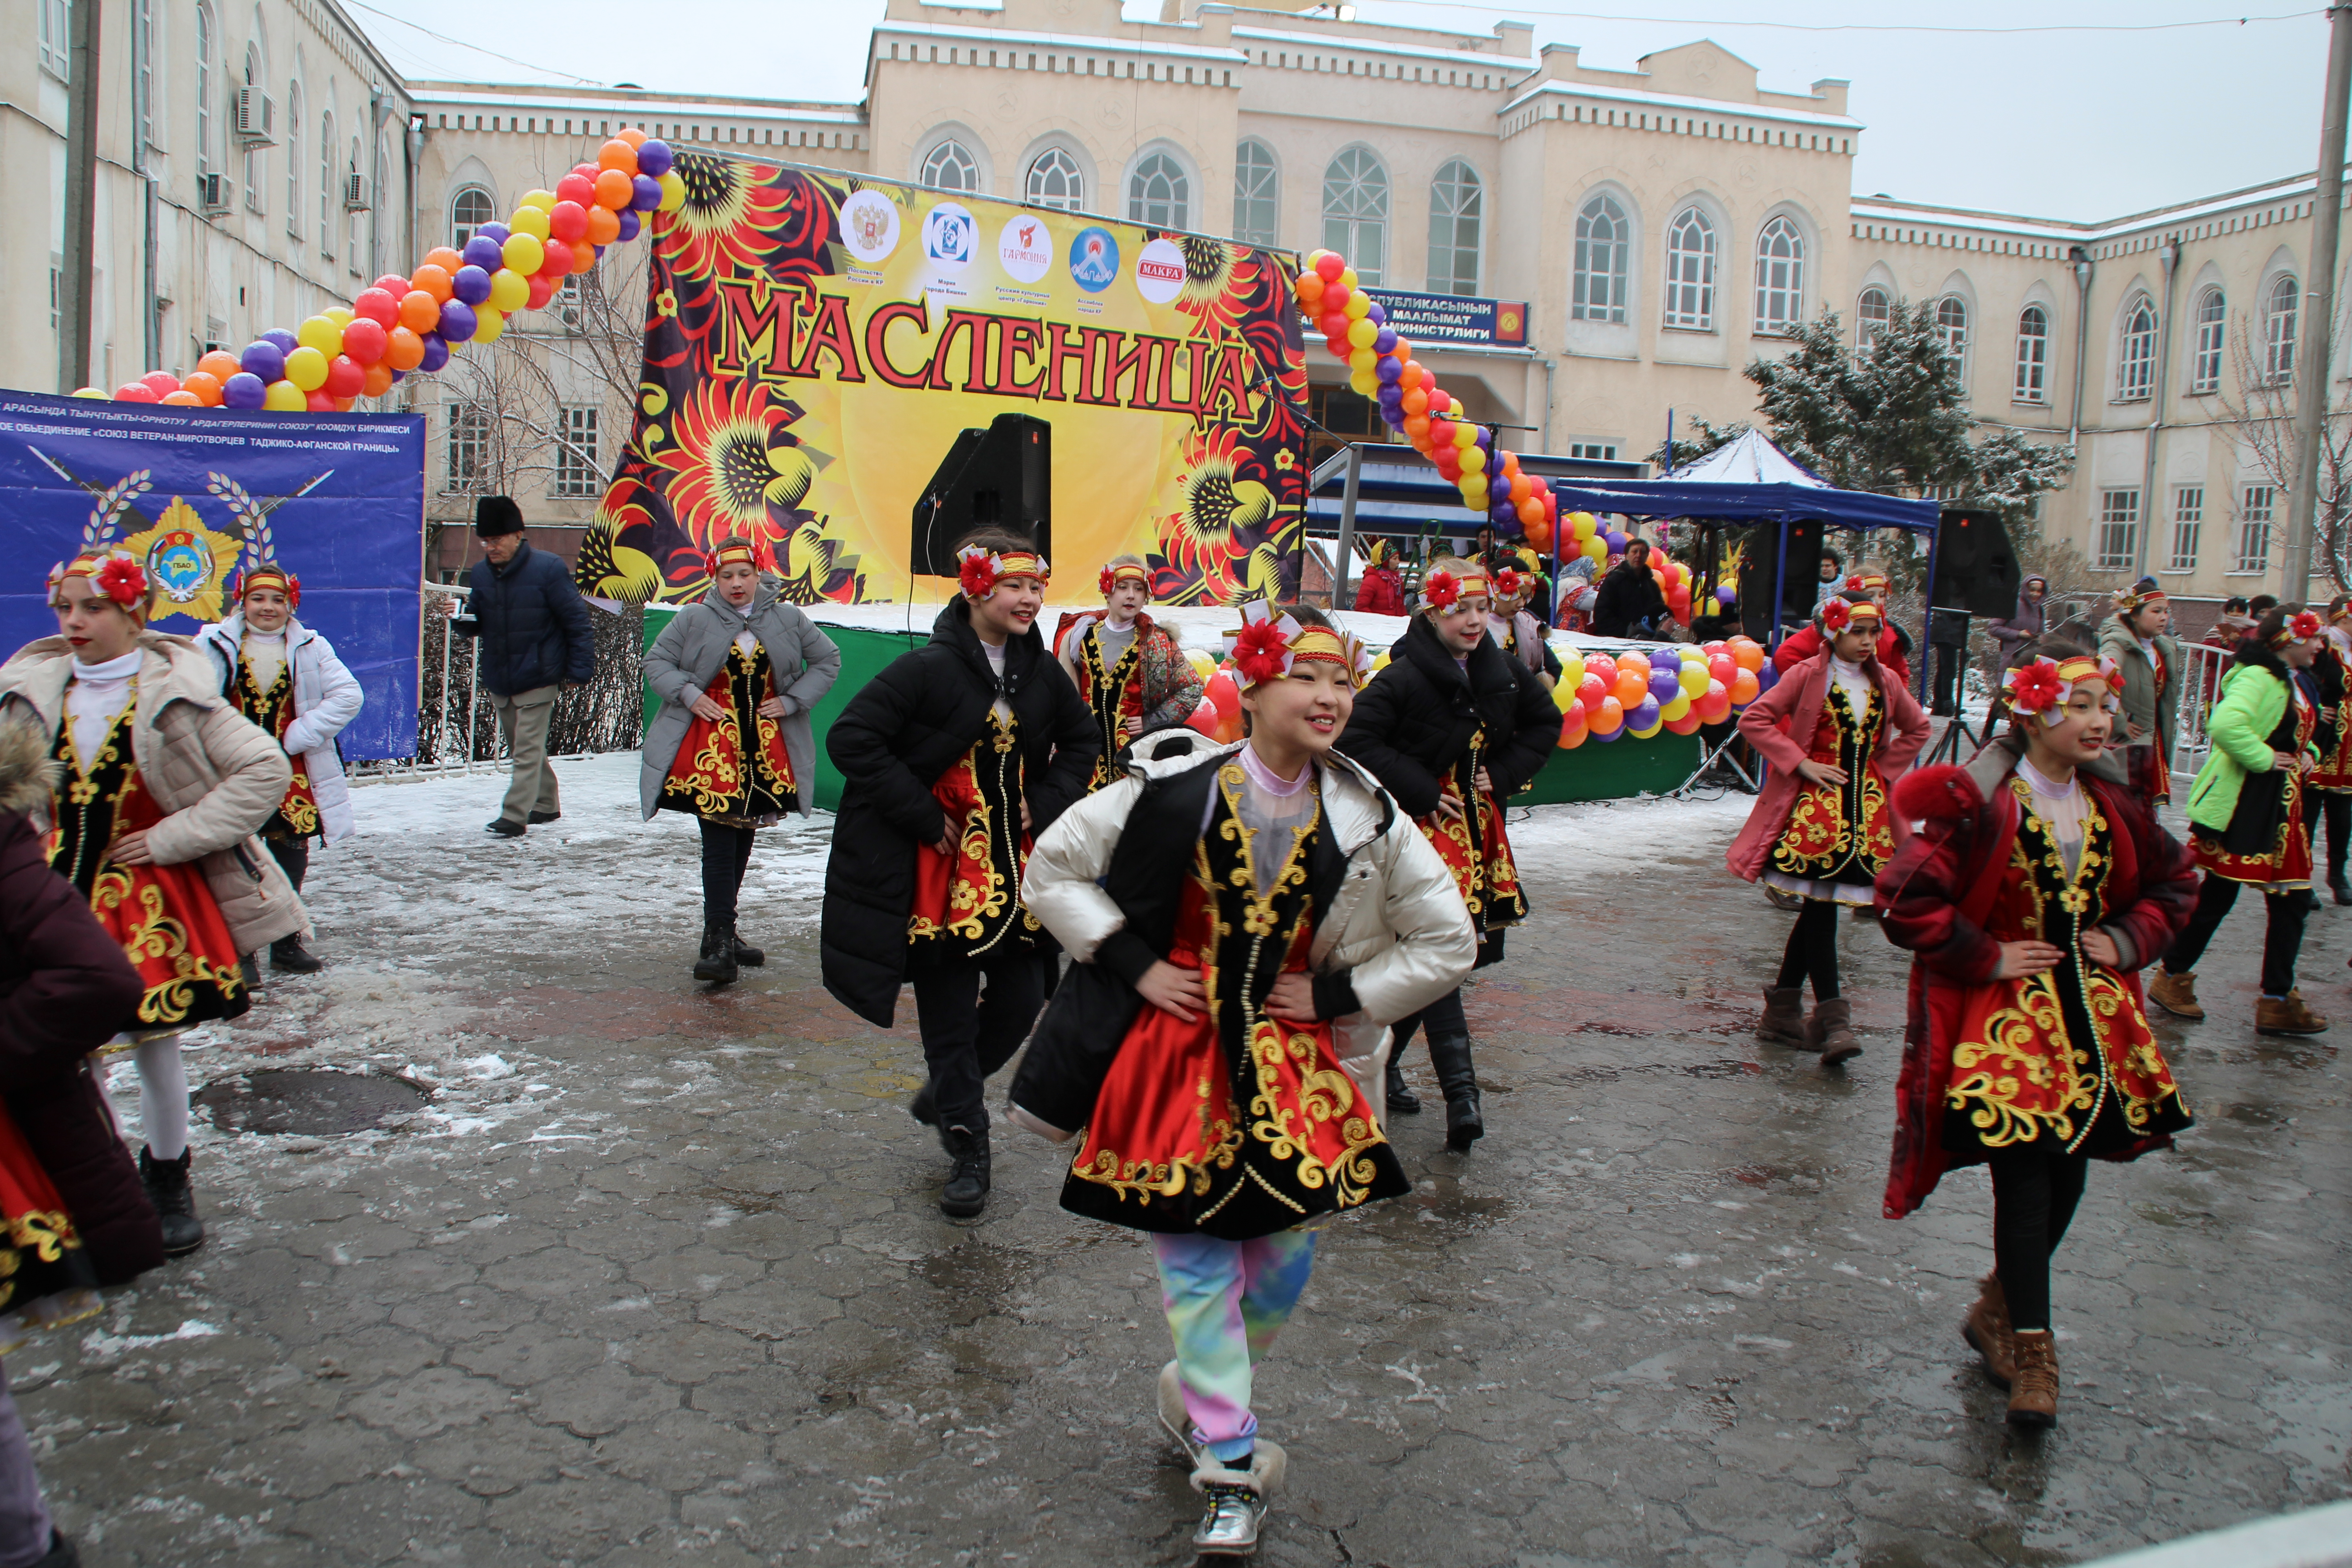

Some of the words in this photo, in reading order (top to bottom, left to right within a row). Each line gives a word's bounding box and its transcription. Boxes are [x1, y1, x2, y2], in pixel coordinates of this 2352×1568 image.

[1004, 248, 1047, 264] ГАРМОНИЯ
[848, 267, 883, 276] Посольство
[1142, 264, 1179, 278] MAKFA
[848, 275, 869, 284] России
[946, 288, 967, 296] Бишкек
[1017, 298, 1047, 306] «Гармония»
[1078, 298, 1103, 307] Ассамблея
[1392, 309, 1472, 325] МААЛЫМАТ
[1389, 321, 1490, 340] МИНИСТРЛИГИ
[717, 280, 1255, 431] МАСЛЕНИЦА
[3, 402, 67, 416] АРАСЫНДА
[70, 408, 188, 426] ТЫНЧТЫКТЫ-ОРНОТУУ
[191, 419, 277, 430] АРДАГЕРЛЕРИНИН
[316, 423, 357, 433] КООМДУК
[358, 424, 410, 434] БИРИКМЕСИ
[93, 428, 128, 439] «СОЮЗ
[130, 431, 245, 446] ВЕТЕРАН-МИРОТВОРЦЕВ
[250, 437, 351, 451] ТАДЖИКО-АФГАНСКОЙ
[353, 442, 400, 454] ГРАНИЦЫ»
